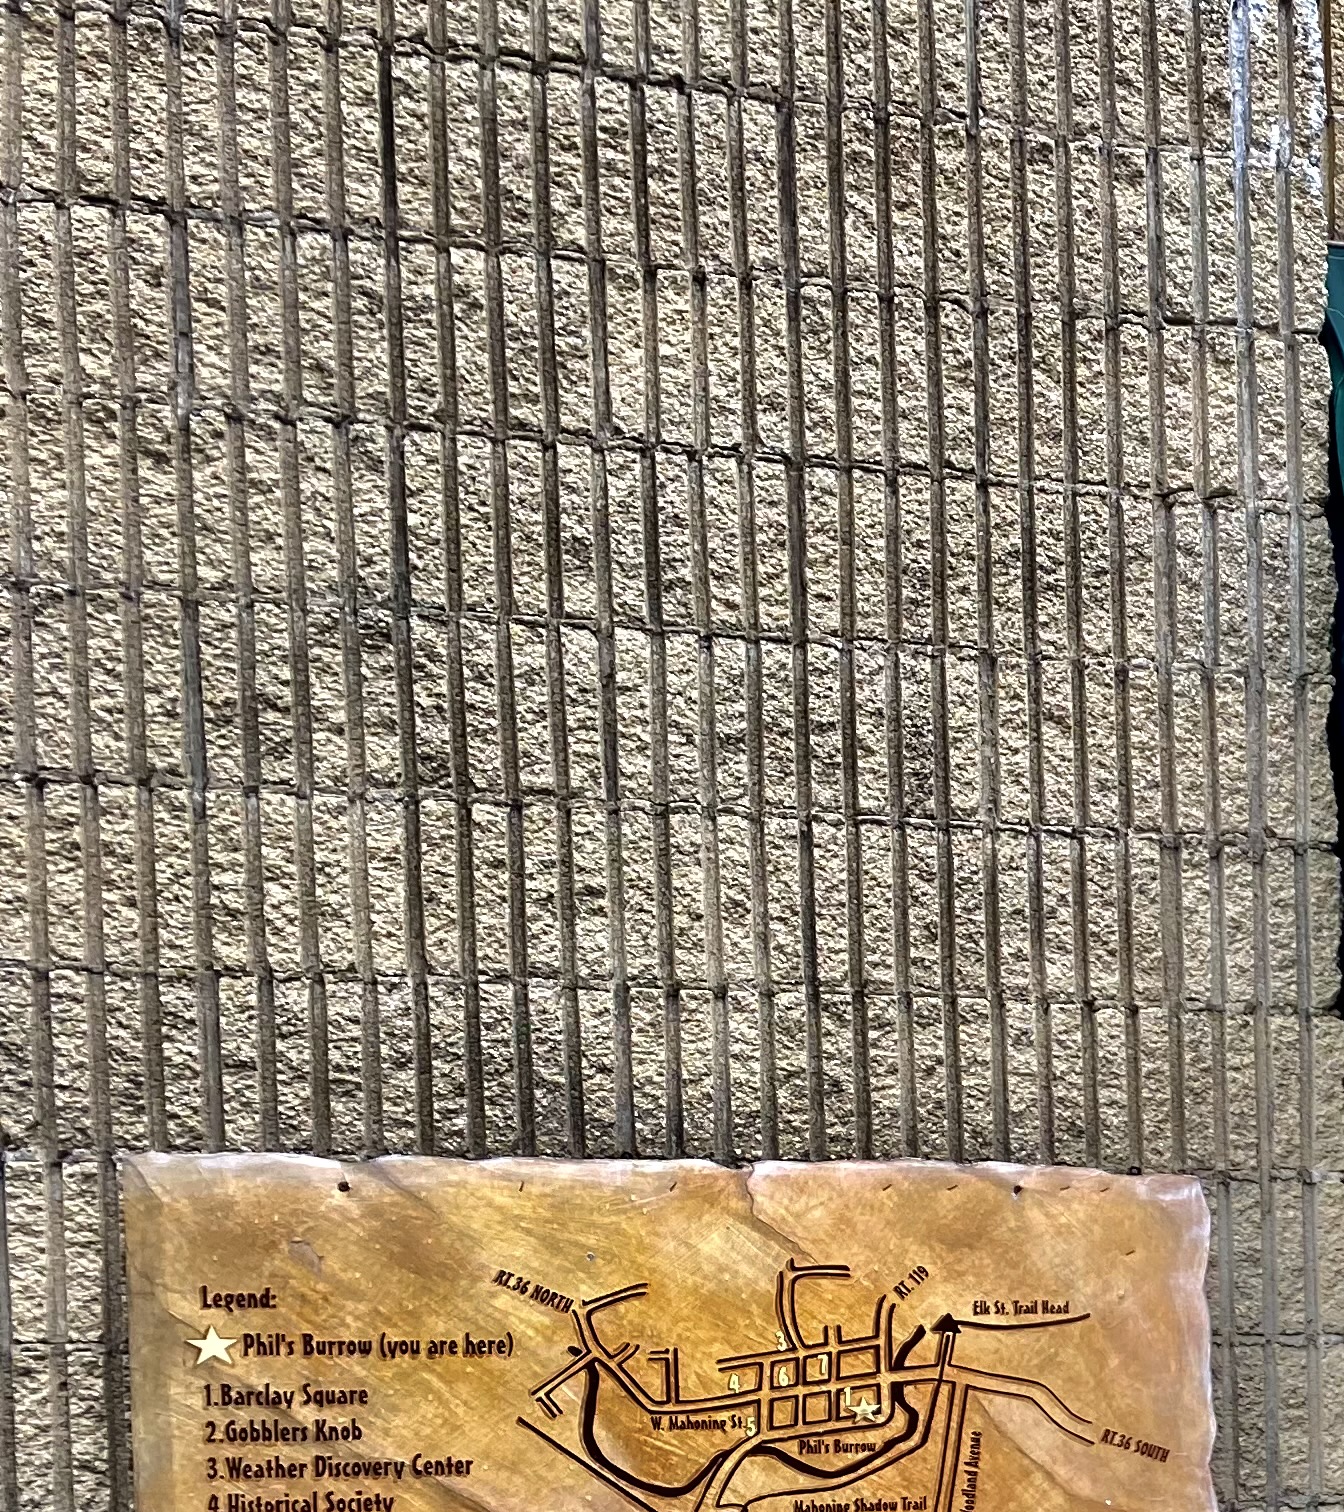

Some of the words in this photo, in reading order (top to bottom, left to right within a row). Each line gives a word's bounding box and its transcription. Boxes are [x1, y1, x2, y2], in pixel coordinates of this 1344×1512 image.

[911, 1265, 930, 1289] 119
[200, 1286, 277, 1313] Legend:
[529, 1284, 574, 1314] NORTH
[973, 1301, 991, 1316] Elk
[995, 1301, 1010, 1315] St.
[1013, 1301, 1038, 1315] Trail
[1042, 1301, 1070, 1315] Head
[242, 1333, 295, 1359] Phil's
[302, 1334, 373, 1358] Burrow
[379, 1332, 421, 1363] (you
[427, 1338, 458, 1357] are
[463, 1332, 515, 1358] here)
[774, 1330, 788, 1351] 3
[818, 1353, 829, 1374] 7
[728, 1373, 741, 1394] 4
[778, 1366, 790, 1387] 6
[302, 1384, 369, 1409] Square
[843, 1386, 852, 1406] 1
[314, 1421, 363, 1443] Knob
[650, 1416, 665, 1432] W.
[669, 1415, 728, 1432] Mahoning
[745, 1416, 756, 1437] 5
[798, 1439, 830, 1454] Phil's
[834, 1438, 877, 1454] Burrow
[964, 1430, 983, 1469] Avenue
[1134, 1438, 1171, 1463] SOUTH
[314, 1456, 405, 1481] Discovery
[411, 1455, 474, 1477] Center
[902, 1497, 927, 1511] Trail
